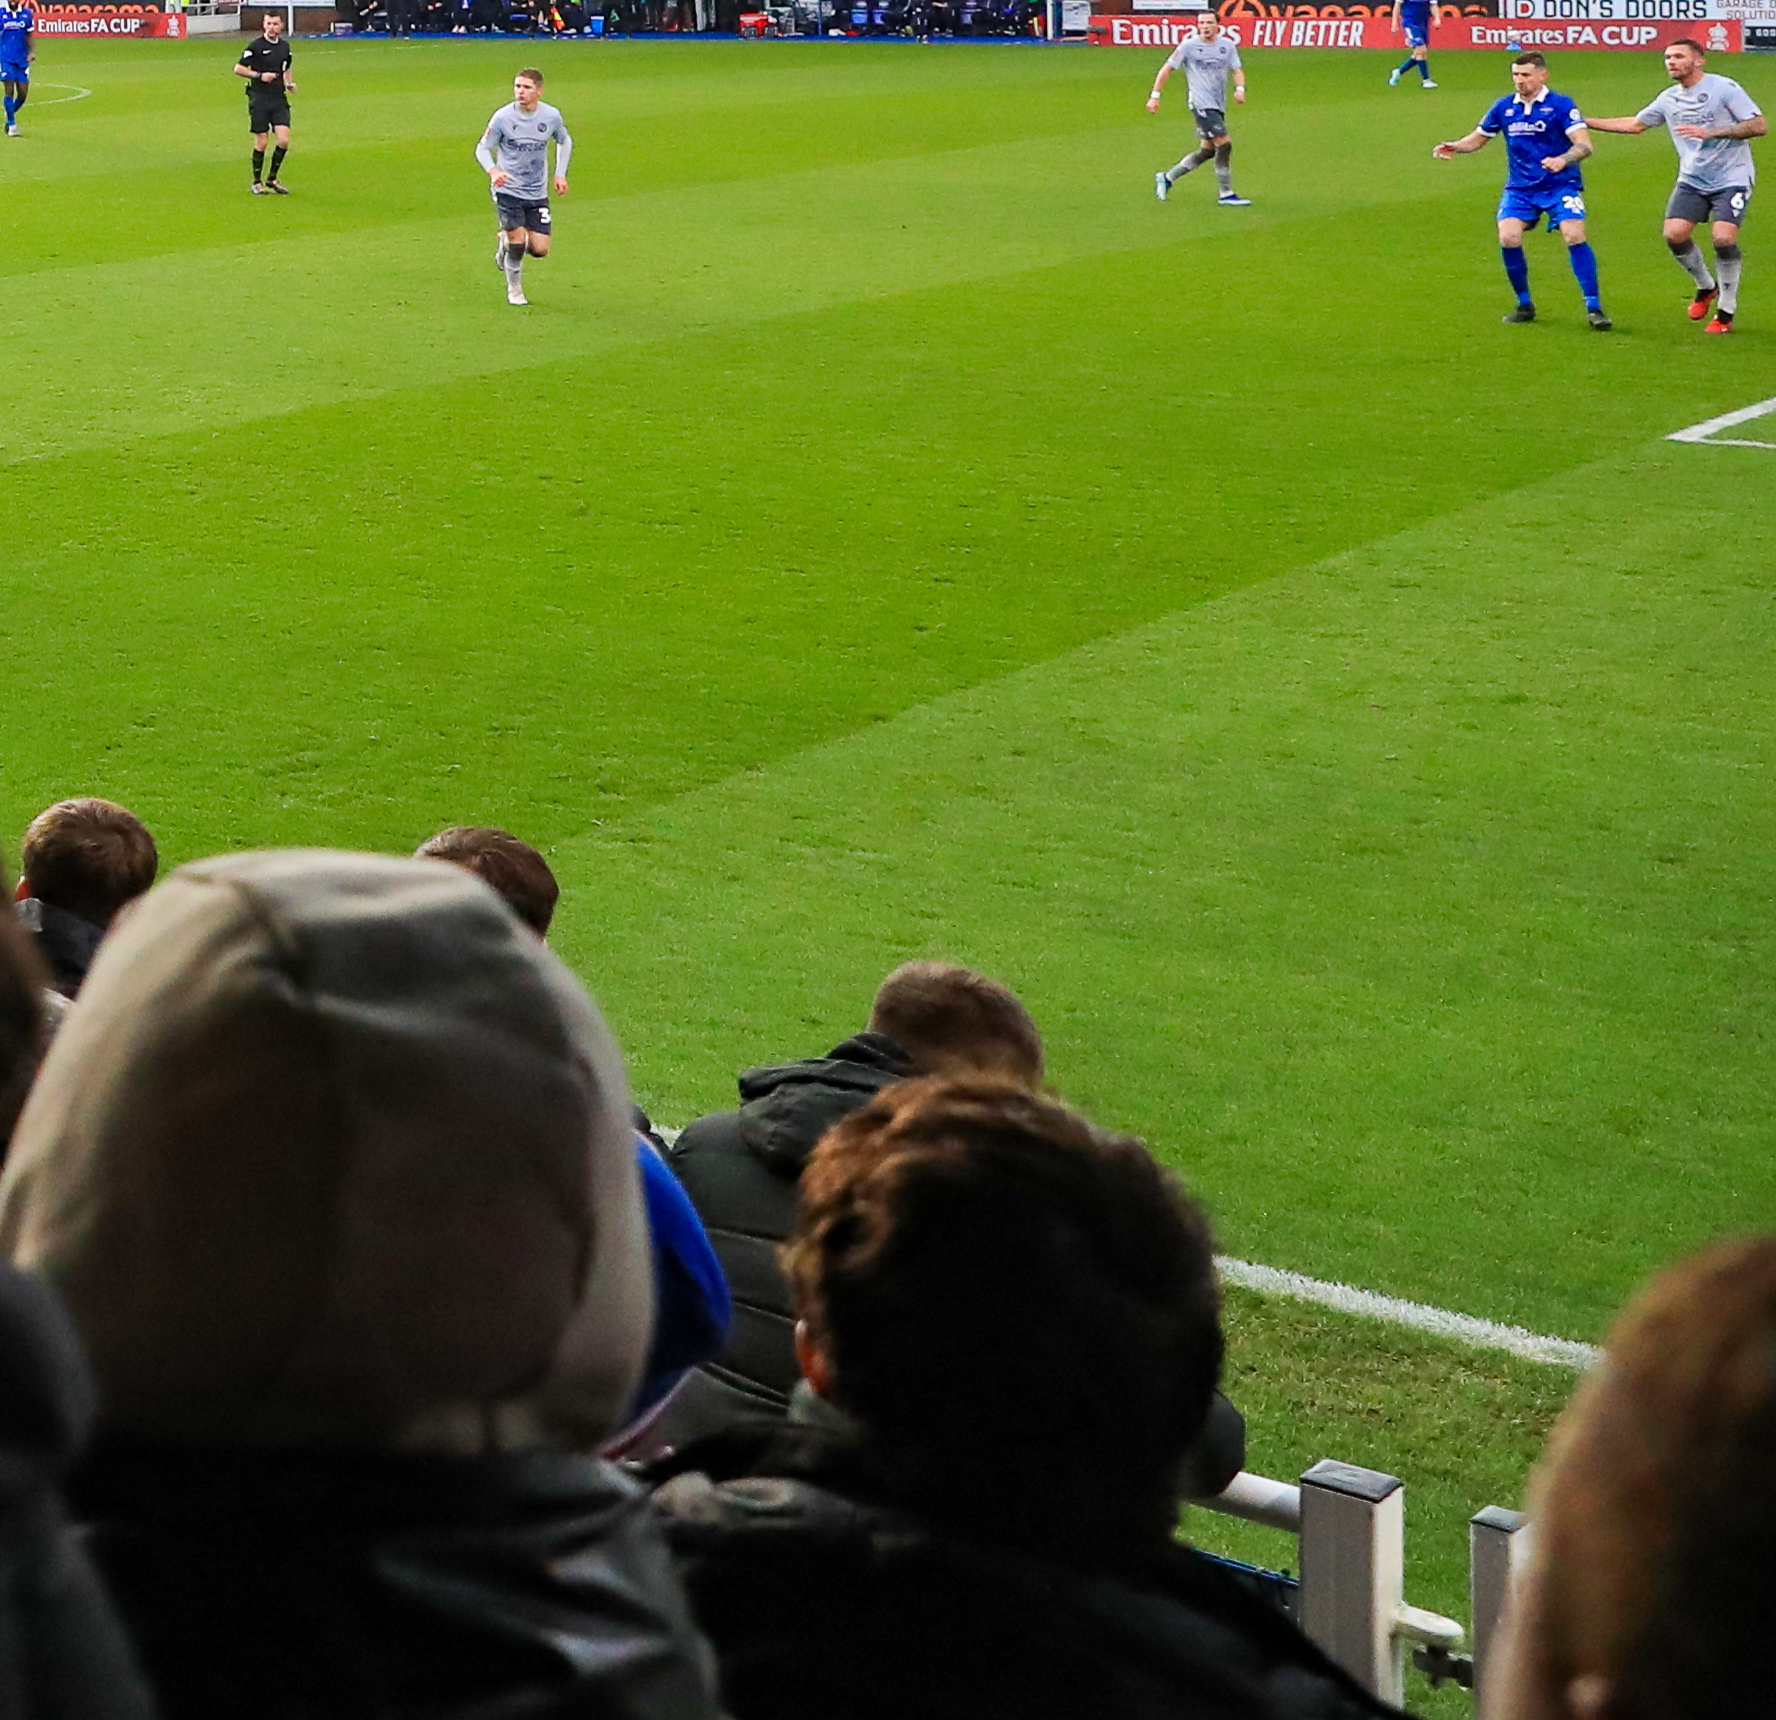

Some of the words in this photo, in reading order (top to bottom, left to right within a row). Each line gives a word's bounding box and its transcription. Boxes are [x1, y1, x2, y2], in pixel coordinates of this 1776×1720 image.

[38, 19, 89, 33] Emirates
[91, 18, 109, 33] FA
[110, 18, 141, 33] CUP
[1253, 20, 1286, 47] FLY
[1290, 19, 1365, 47] BETTER
[1567, 26, 1599, 45] FA
[1602, 26, 1658, 45] CUP
[1562, 195, 1585, 210] 20
[1730, 192, 1745, 210] 6
[540, 206, 552, 224] 3
